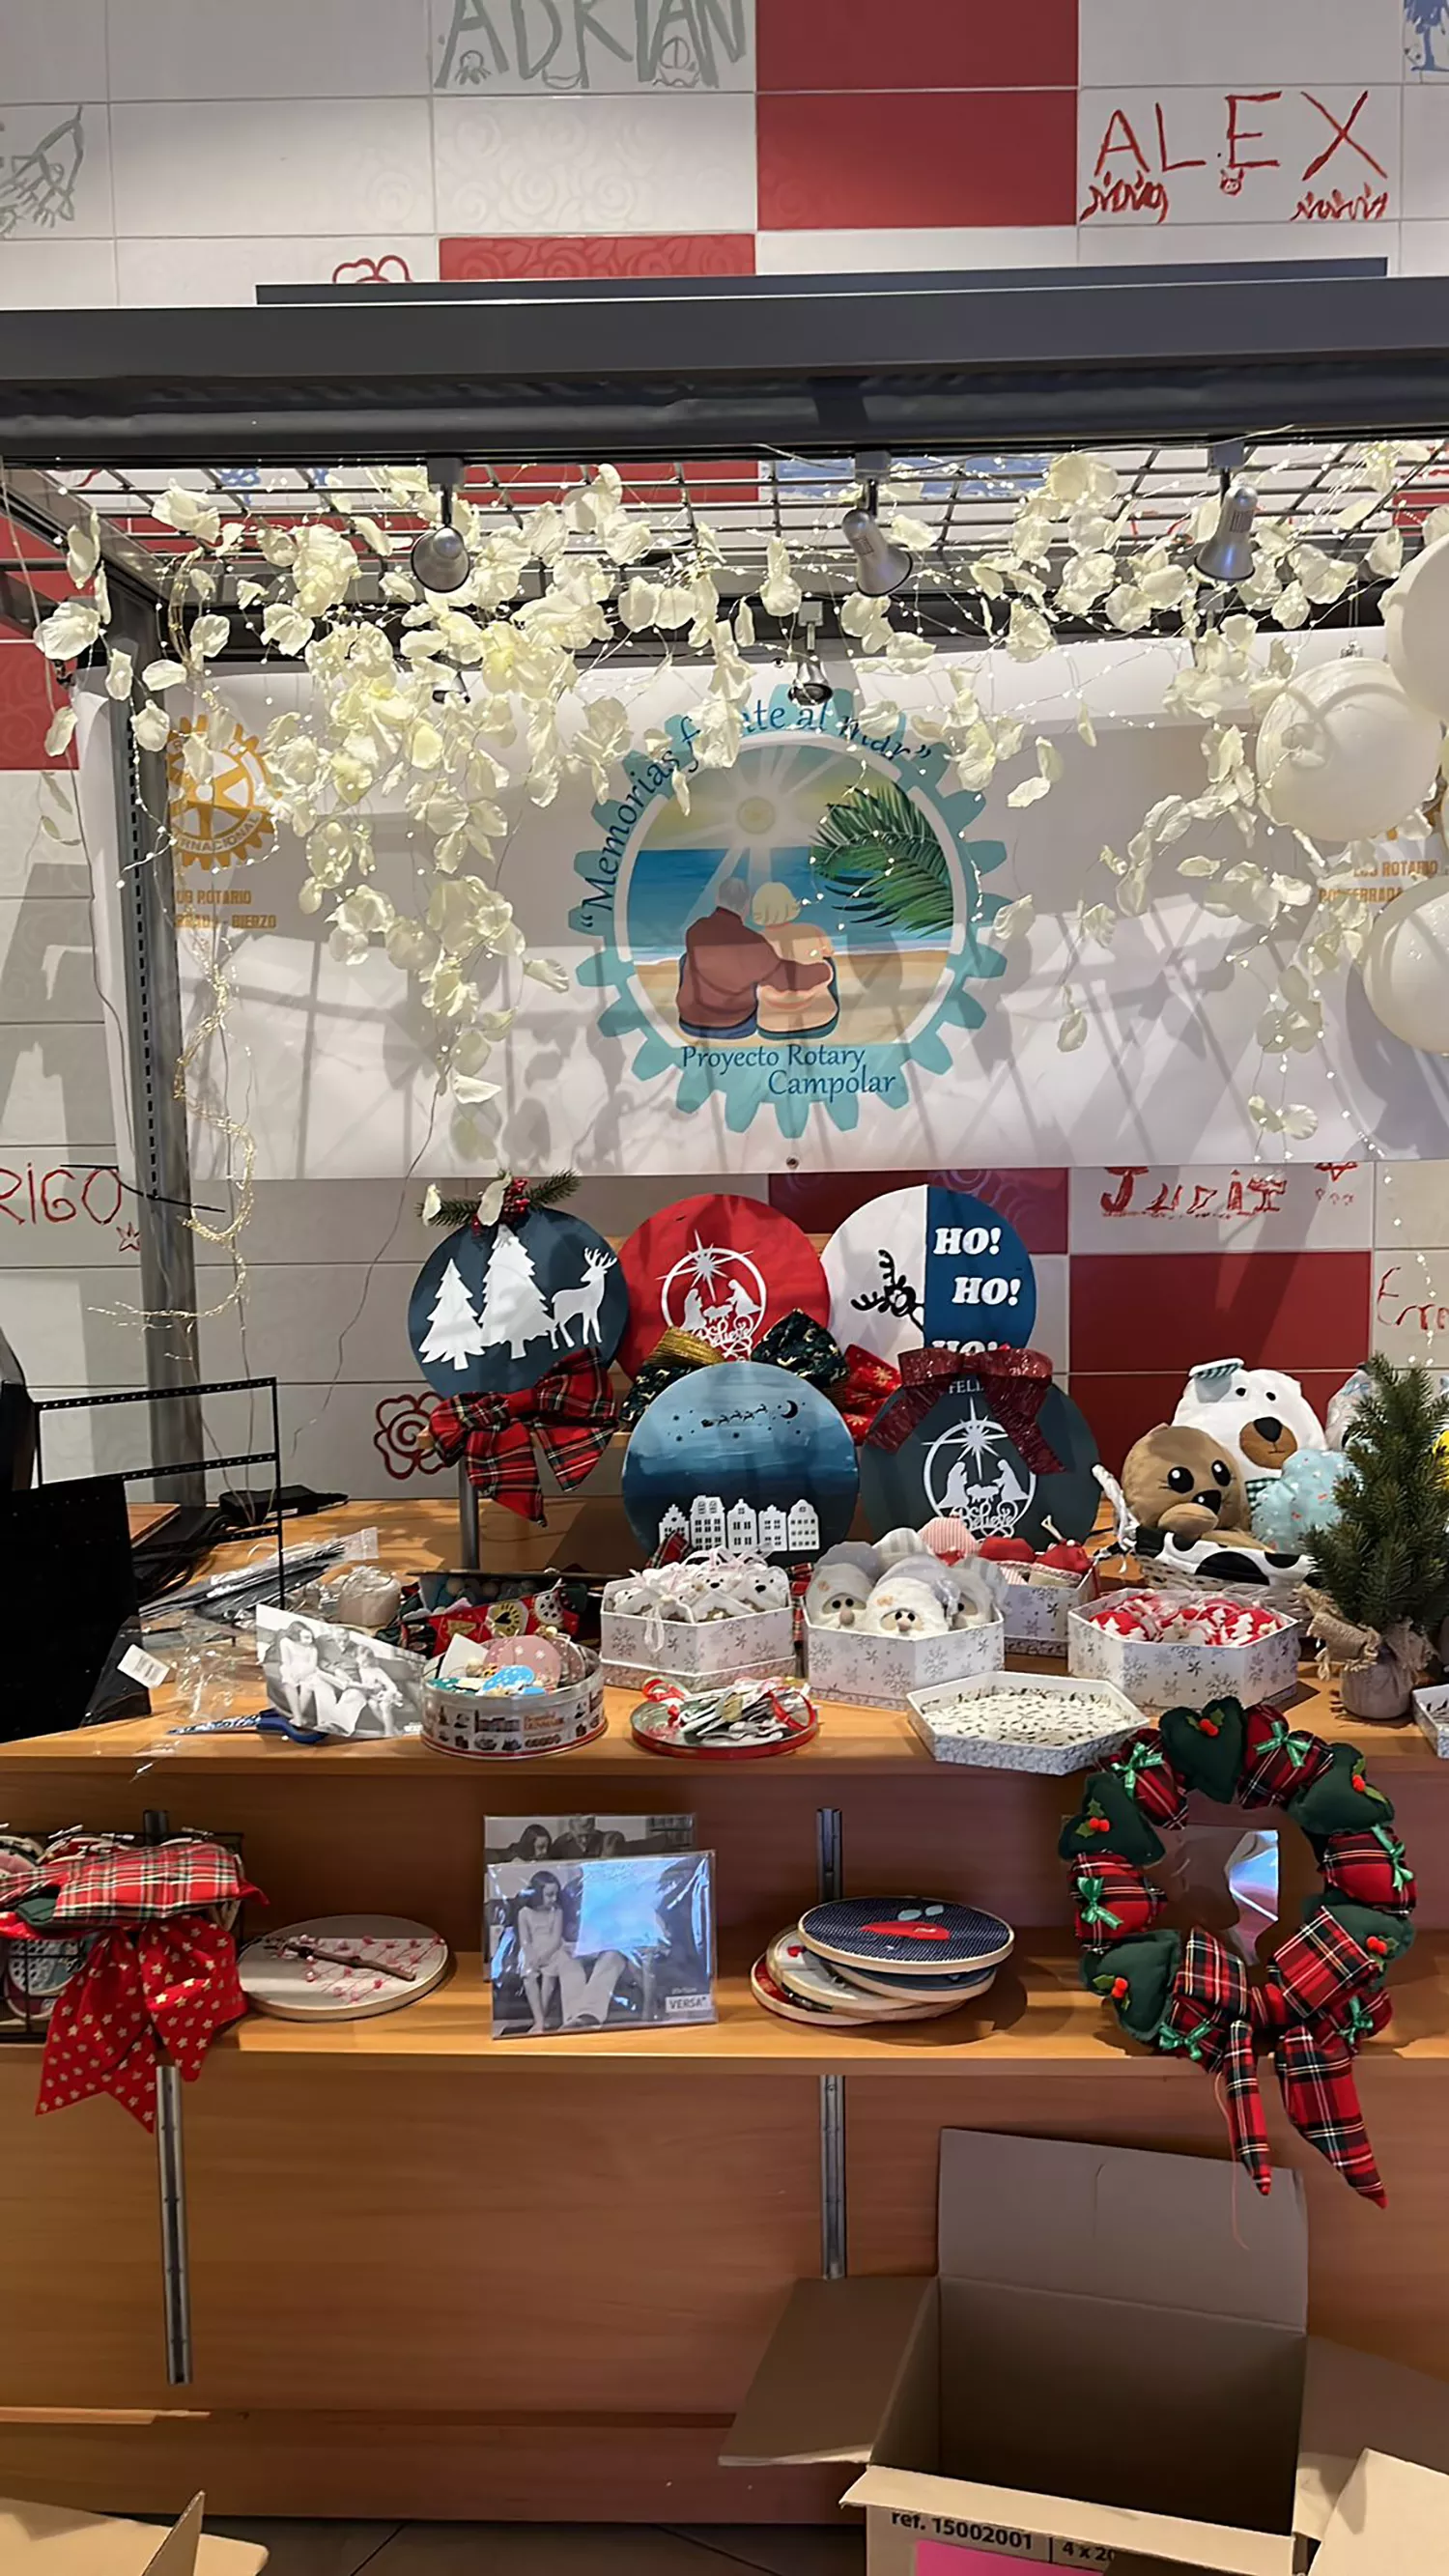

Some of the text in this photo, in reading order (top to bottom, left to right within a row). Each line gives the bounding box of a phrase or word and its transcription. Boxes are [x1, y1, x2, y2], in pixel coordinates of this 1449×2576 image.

[1094, 90, 1388, 182] ALEX
[796, 701, 830, 732] al
[196, 890, 252, 905] ROTARIO
[231, 914, 277, 929] BIERZO
[681, 1043, 866, 1076] Proyecto Rotary
[768, 1064, 896, 1103] Campolar
[932, 1227, 1002, 1256] HO!
[952, 1276, 1022, 1307] HO!
[931, 2517, 1033, 2551] 15002001
[1062, 2540, 1074, 2558] 4
